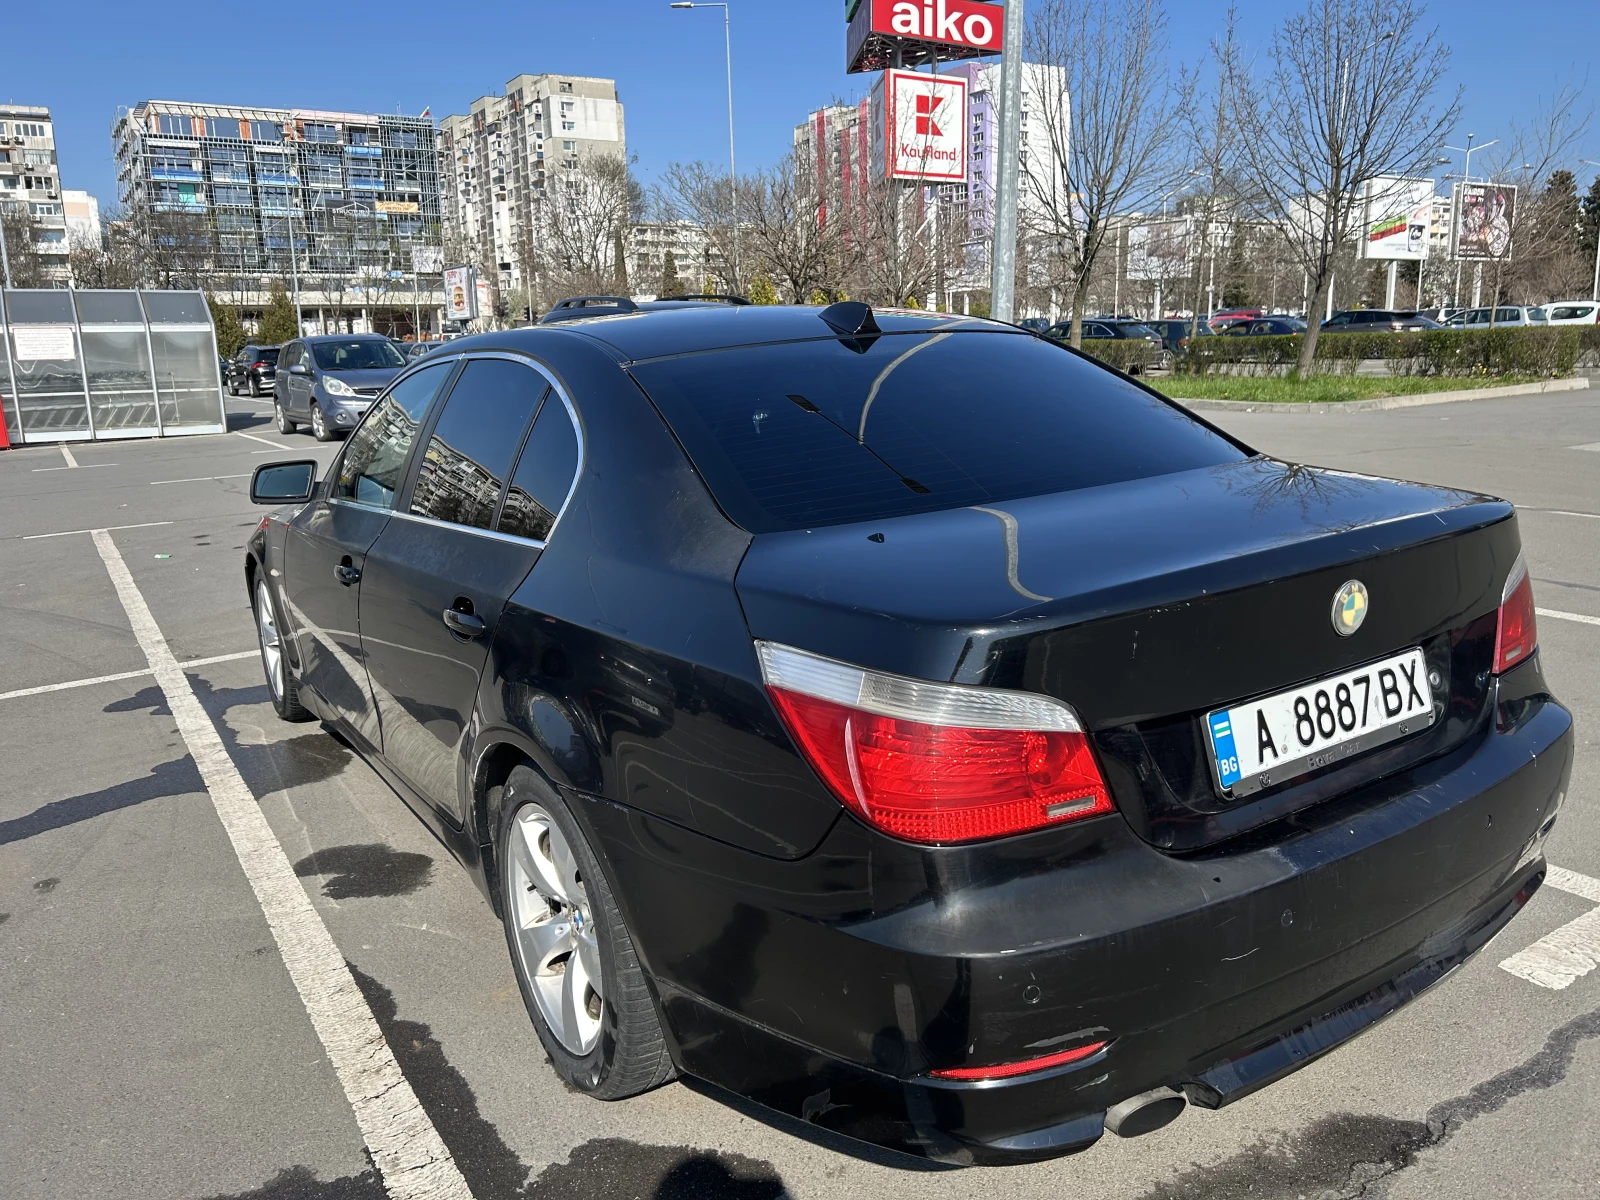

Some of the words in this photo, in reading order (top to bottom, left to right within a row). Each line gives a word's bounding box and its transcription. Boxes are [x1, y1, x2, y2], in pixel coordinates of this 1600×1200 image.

[891, 0, 993, 45] aiko
[901, 143, 957, 161] Kaufland
[1257, 708, 1278, 765] A
[1293, 675, 1371, 748] 8887
[1378, 659, 1425, 719] BX
[1221, 757, 1238, 776] BG
